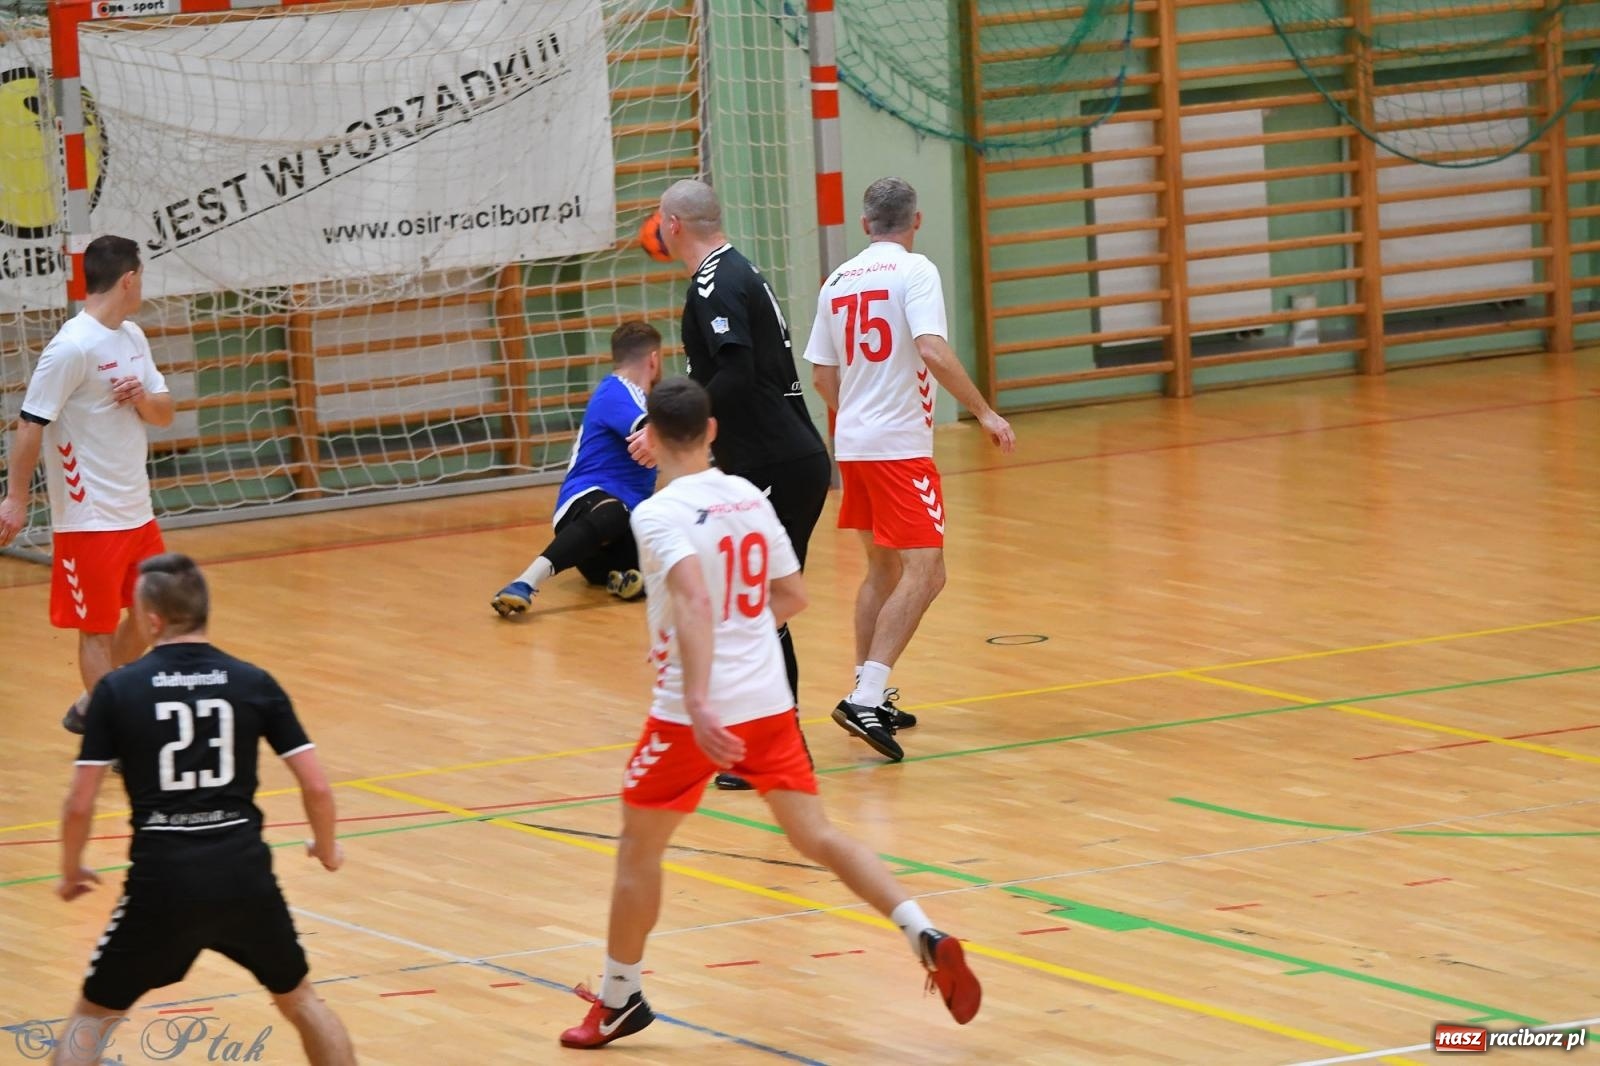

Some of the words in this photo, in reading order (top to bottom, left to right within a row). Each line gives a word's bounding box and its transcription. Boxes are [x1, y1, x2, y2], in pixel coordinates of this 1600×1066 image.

[133, 0, 164, 13] sport
[147, 173, 248, 250] JEST
[261, 152, 304, 198] W
[322, 195, 583, 245] www.osir-raciborz.pl
[831, 289, 892, 366] 75
[717, 530, 769, 623] 19
[155, 698, 235, 791] 23
